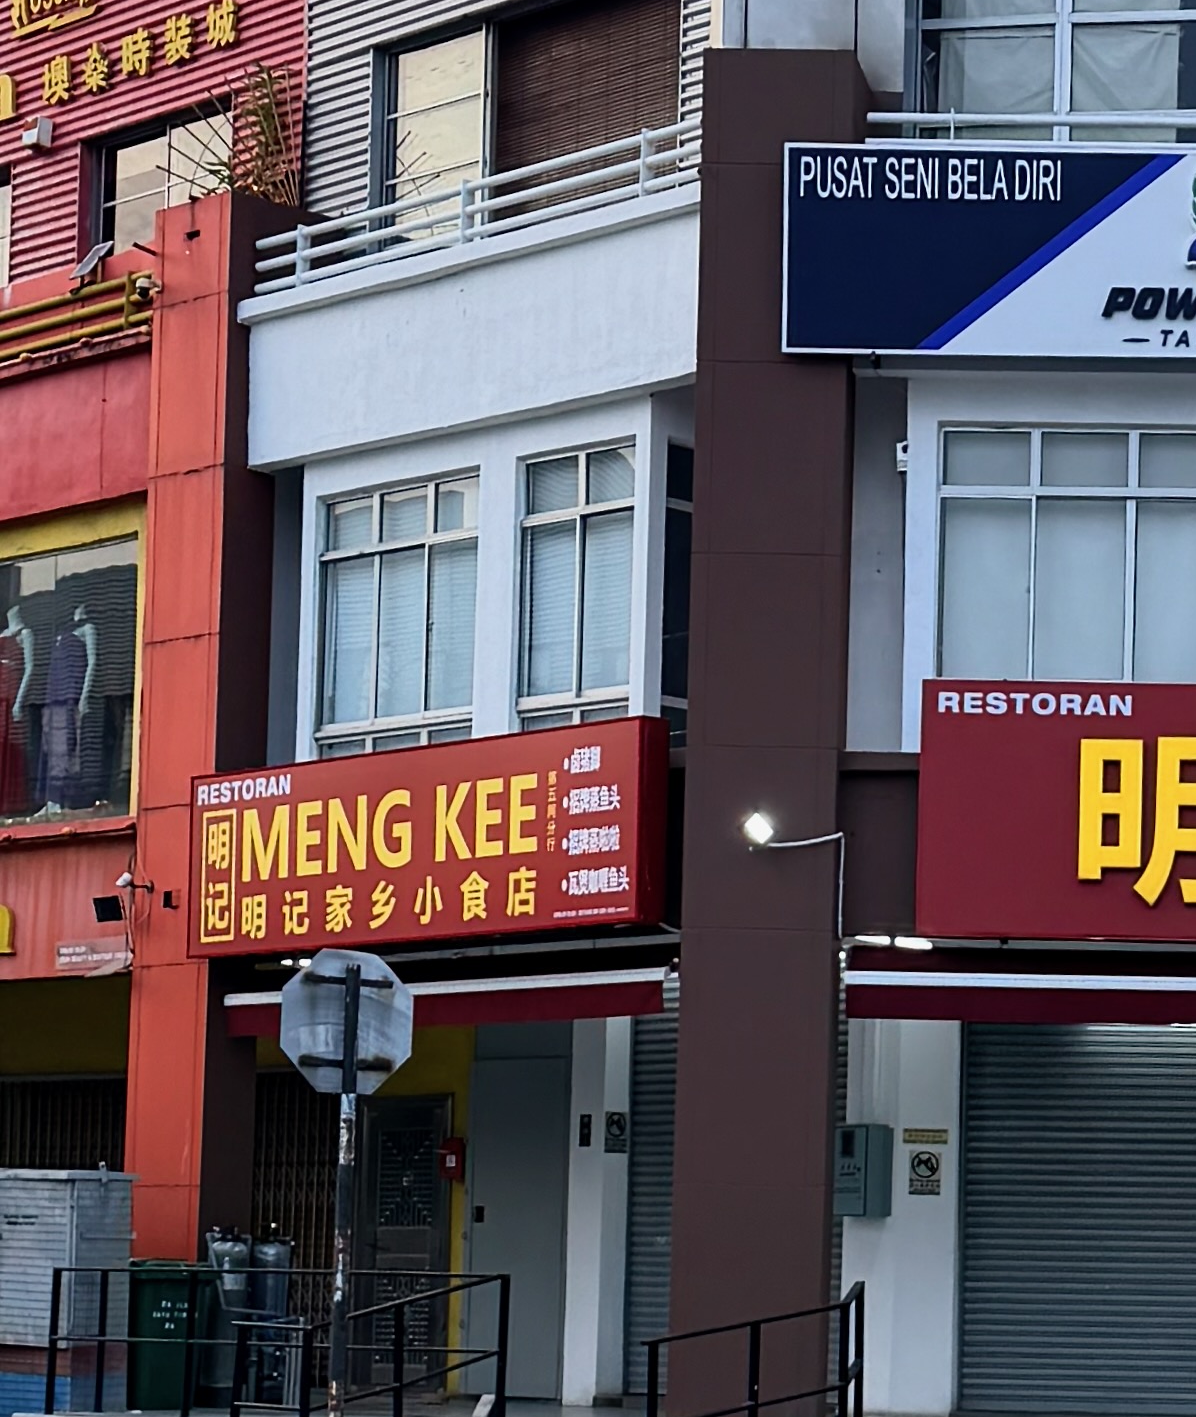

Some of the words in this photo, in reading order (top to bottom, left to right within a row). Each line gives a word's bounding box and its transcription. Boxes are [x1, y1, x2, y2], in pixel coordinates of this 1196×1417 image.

[799, 156, 878, 199] PUSAT
[885, 158, 940, 200] SENI
[947, 159, 1008, 201] BELA
[1014, 160, 1062, 202] DIRI
[937, 692, 1133, 717] RESTORAN
[196, 773, 291, 807] RESTORAN
[241, 788, 413, 883] MENG
[434, 772, 539, 863] KEE
[205, 822, 231, 932] 明记
[241, 866, 538, 940] 明记家乡小食店
